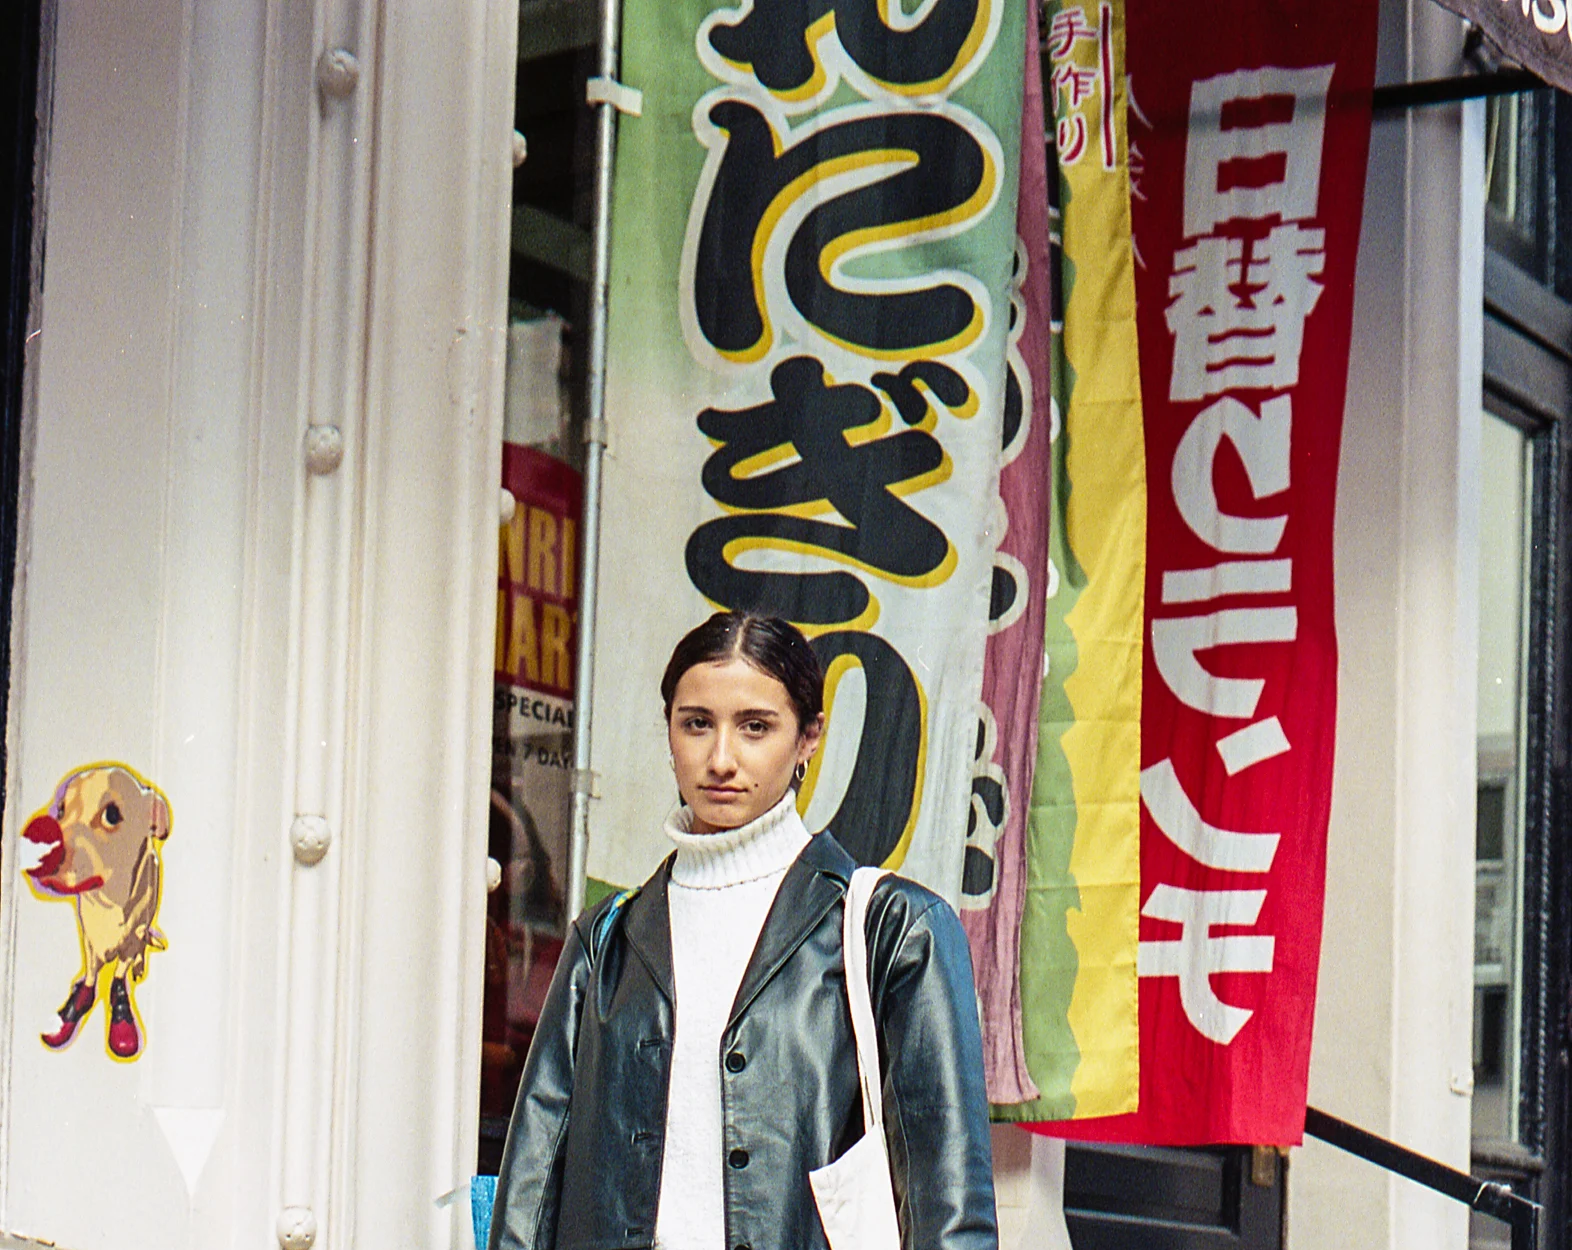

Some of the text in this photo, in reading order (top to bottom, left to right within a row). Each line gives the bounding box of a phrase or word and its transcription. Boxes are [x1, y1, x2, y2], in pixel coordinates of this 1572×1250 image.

[1047, 9, 1098, 166] 手作り
[523, 741, 533, 761] 7
